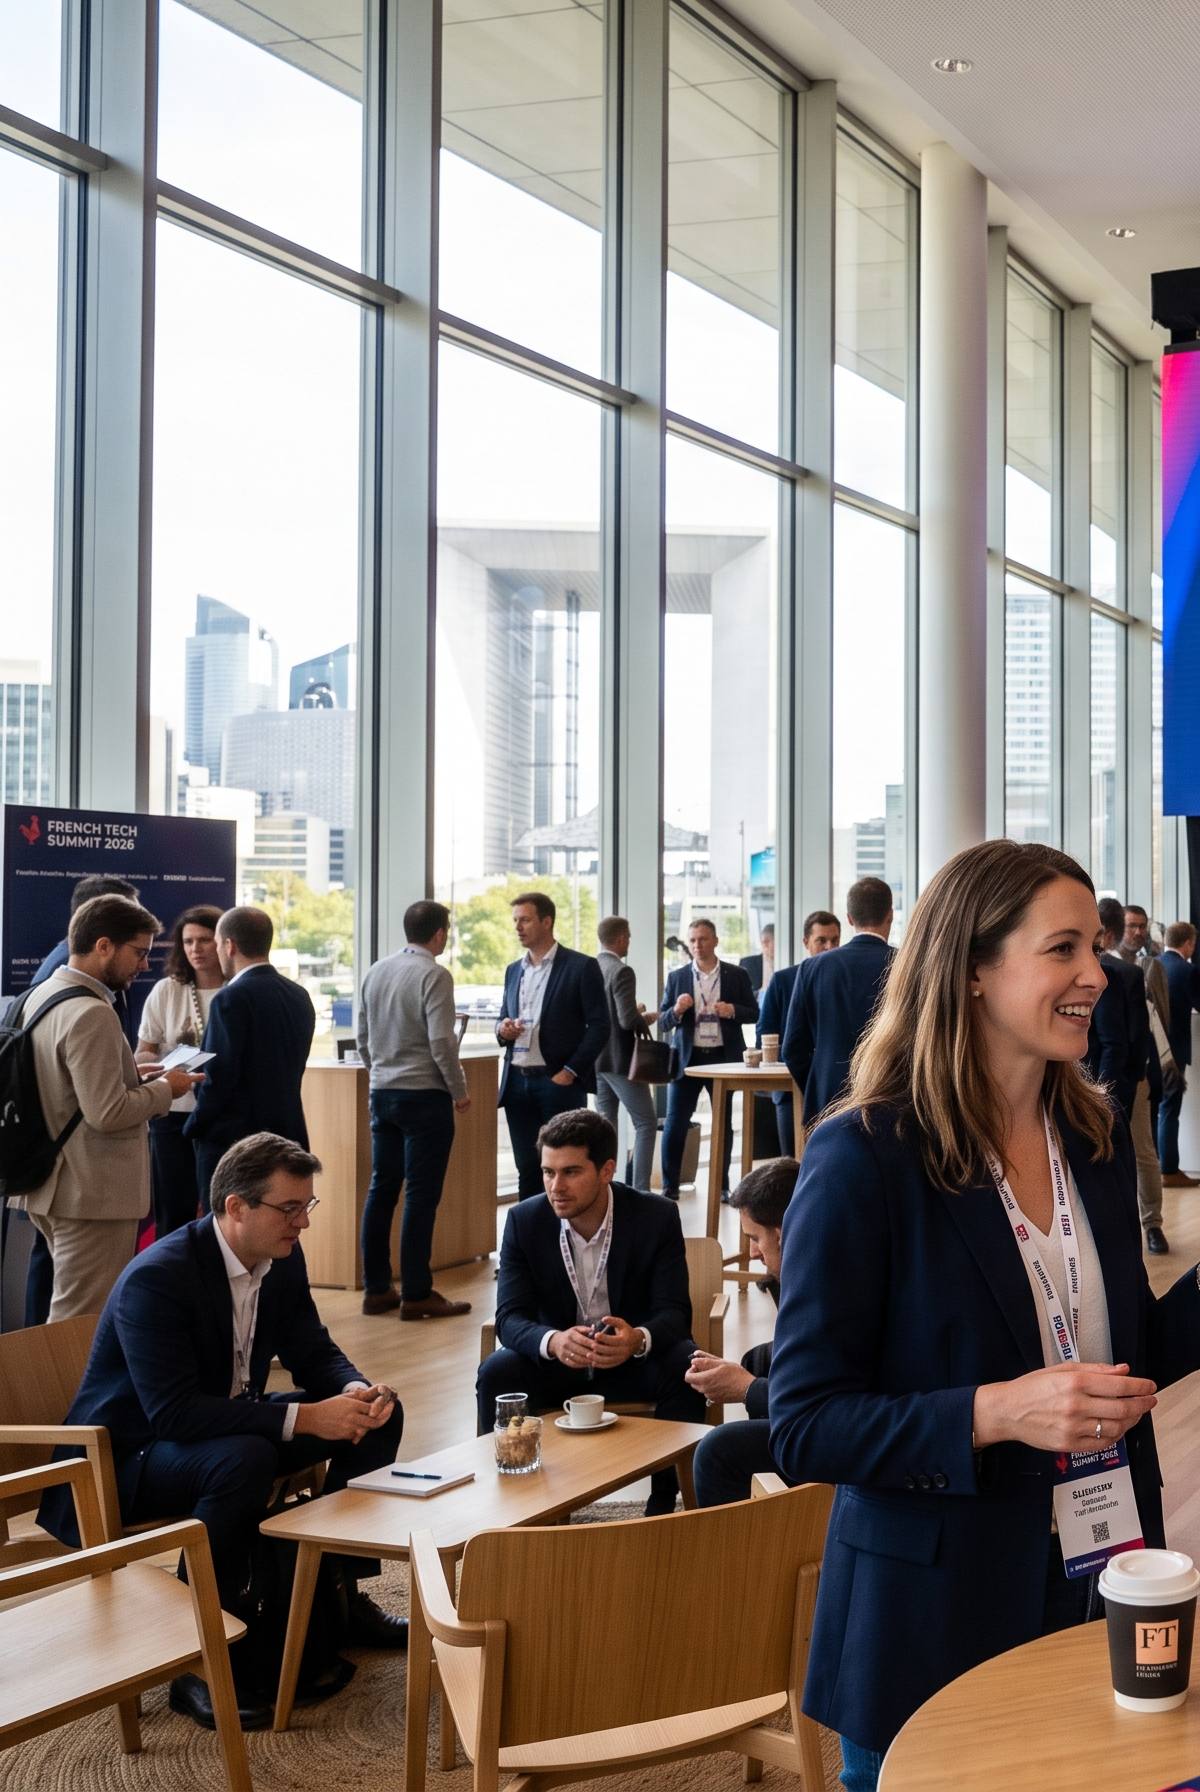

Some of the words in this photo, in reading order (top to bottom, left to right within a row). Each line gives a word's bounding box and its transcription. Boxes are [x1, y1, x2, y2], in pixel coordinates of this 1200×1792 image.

[47, 820, 102, 836] FRENCH
[104, 823, 138, 837] TECH
[47, 834, 102, 849] SUMMIT
[104, 837, 135, 850] 2026
[1141, 1625, 1176, 1649] FT
